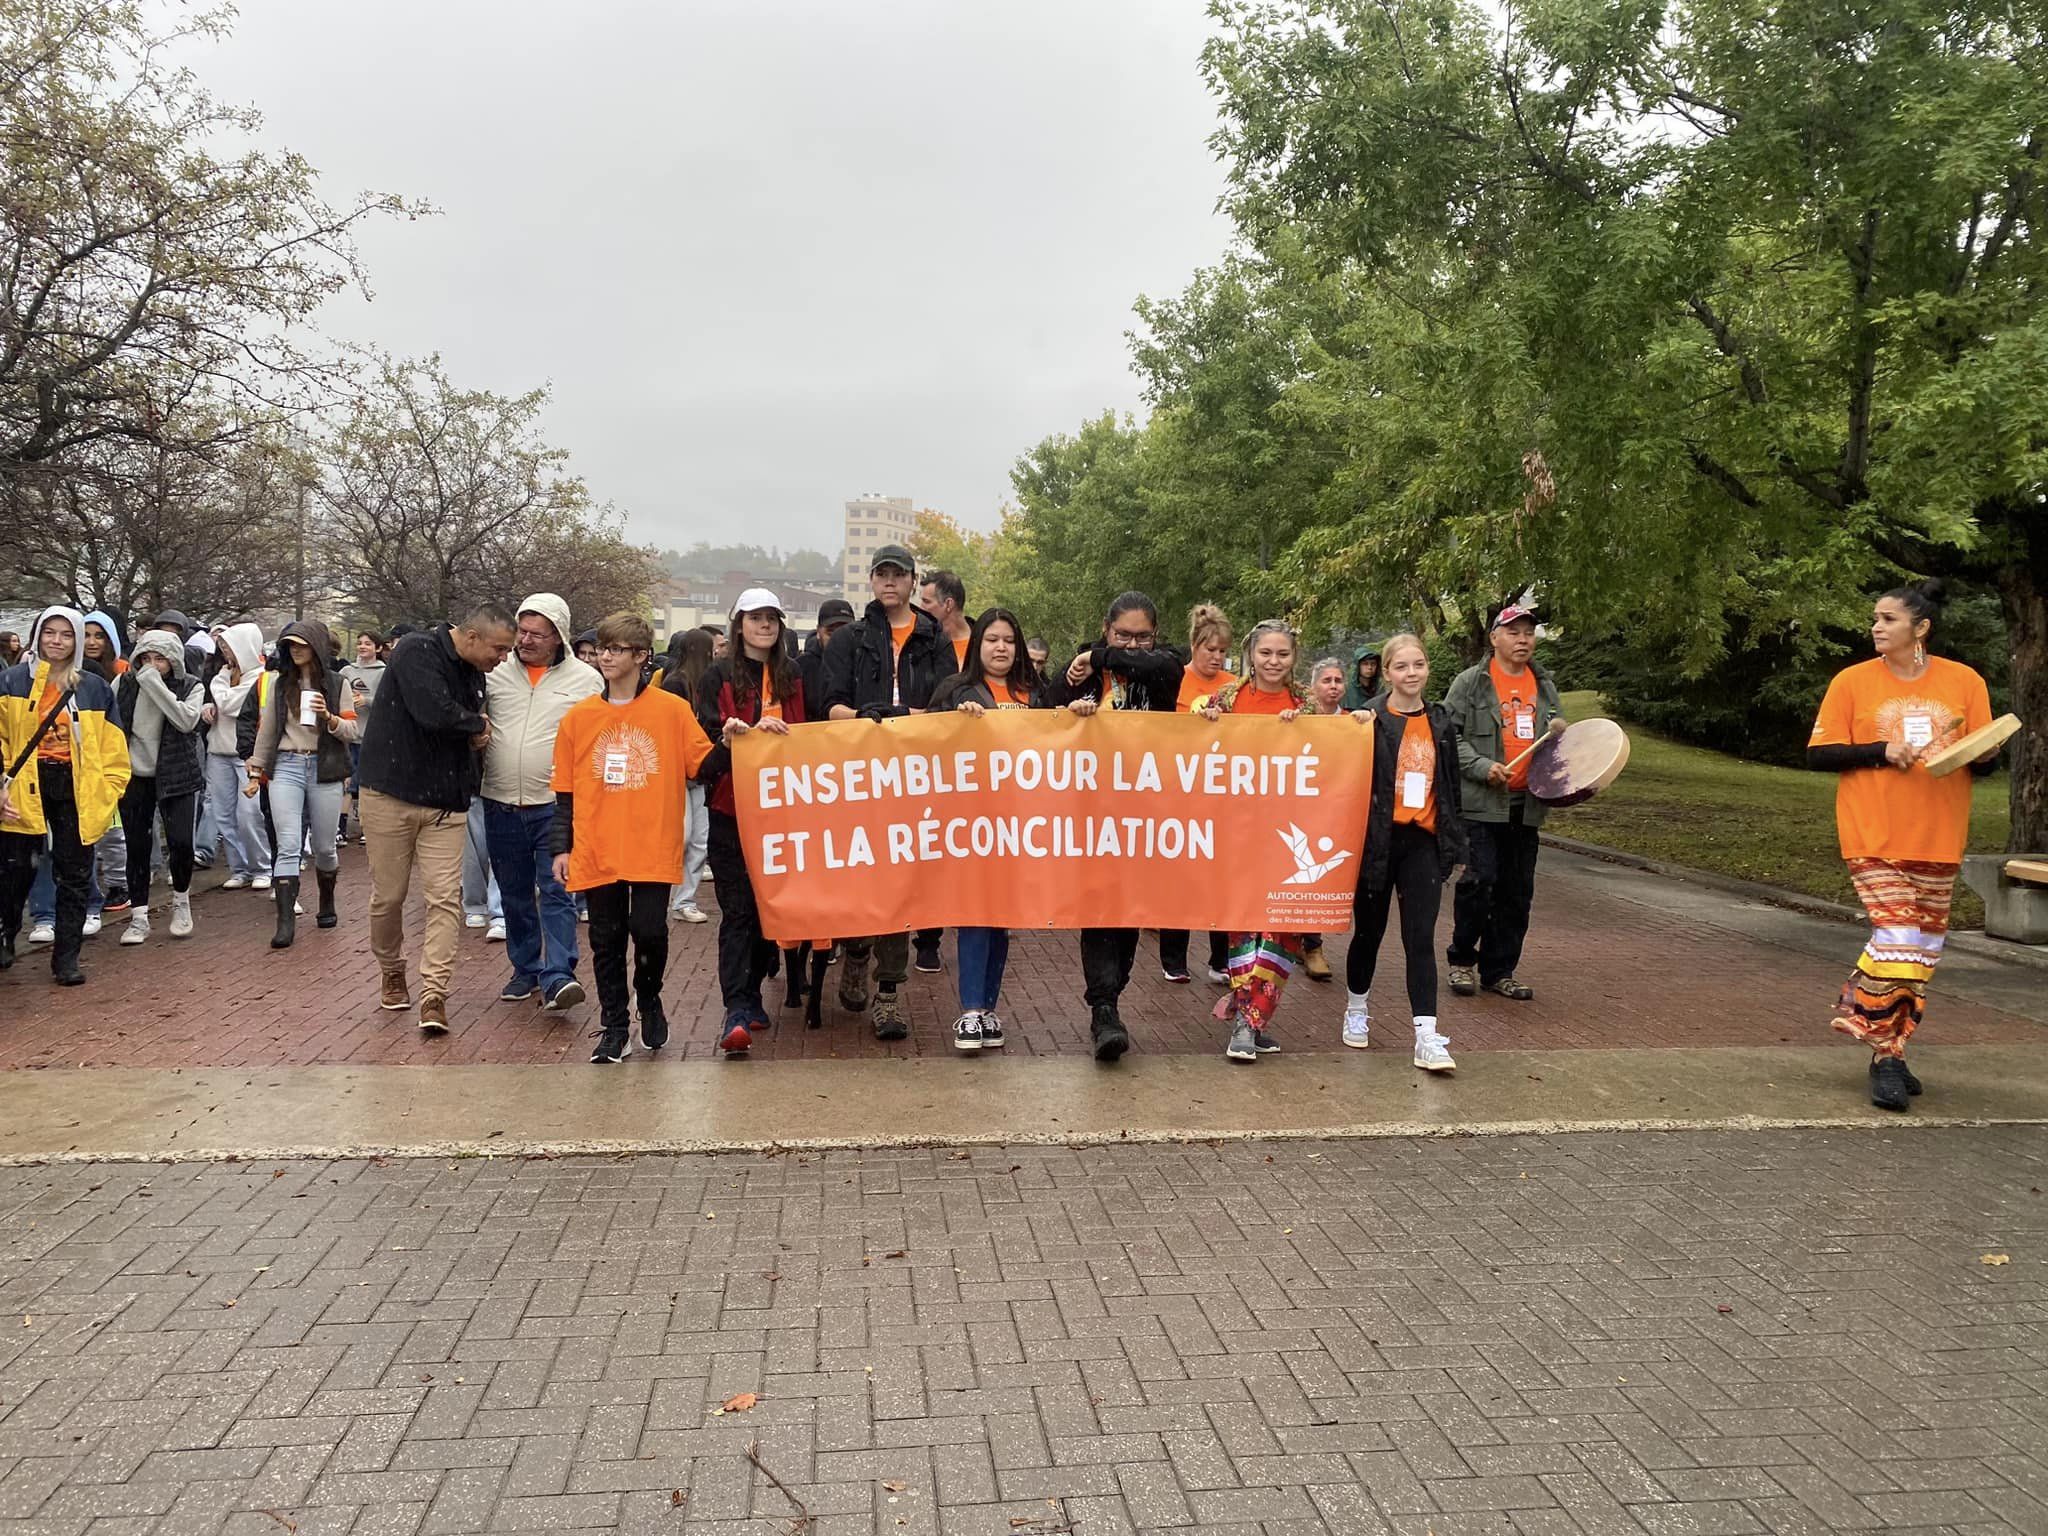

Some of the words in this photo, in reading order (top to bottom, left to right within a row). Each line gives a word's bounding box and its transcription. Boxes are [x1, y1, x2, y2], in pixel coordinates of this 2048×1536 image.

[759, 750, 978, 809] ENSEMBLE
[989, 748, 1098, 792] POUR
[1113, 750, 1162, 793] LA
[1175, 742, 1320, 796] VÉRITÉ
[762, 831, 810, 875] ET
[823, 826, 875, 869] LA
[887, 807, 1215, 864] RÉCONCILIATION
[1267, 891, 1354, 901] AUTOCHTONISATIO
[1266, 907, 1292, 915] Centre
[1294, 907, 1303, 915] de
[1269, 916, 1283, 925] des
